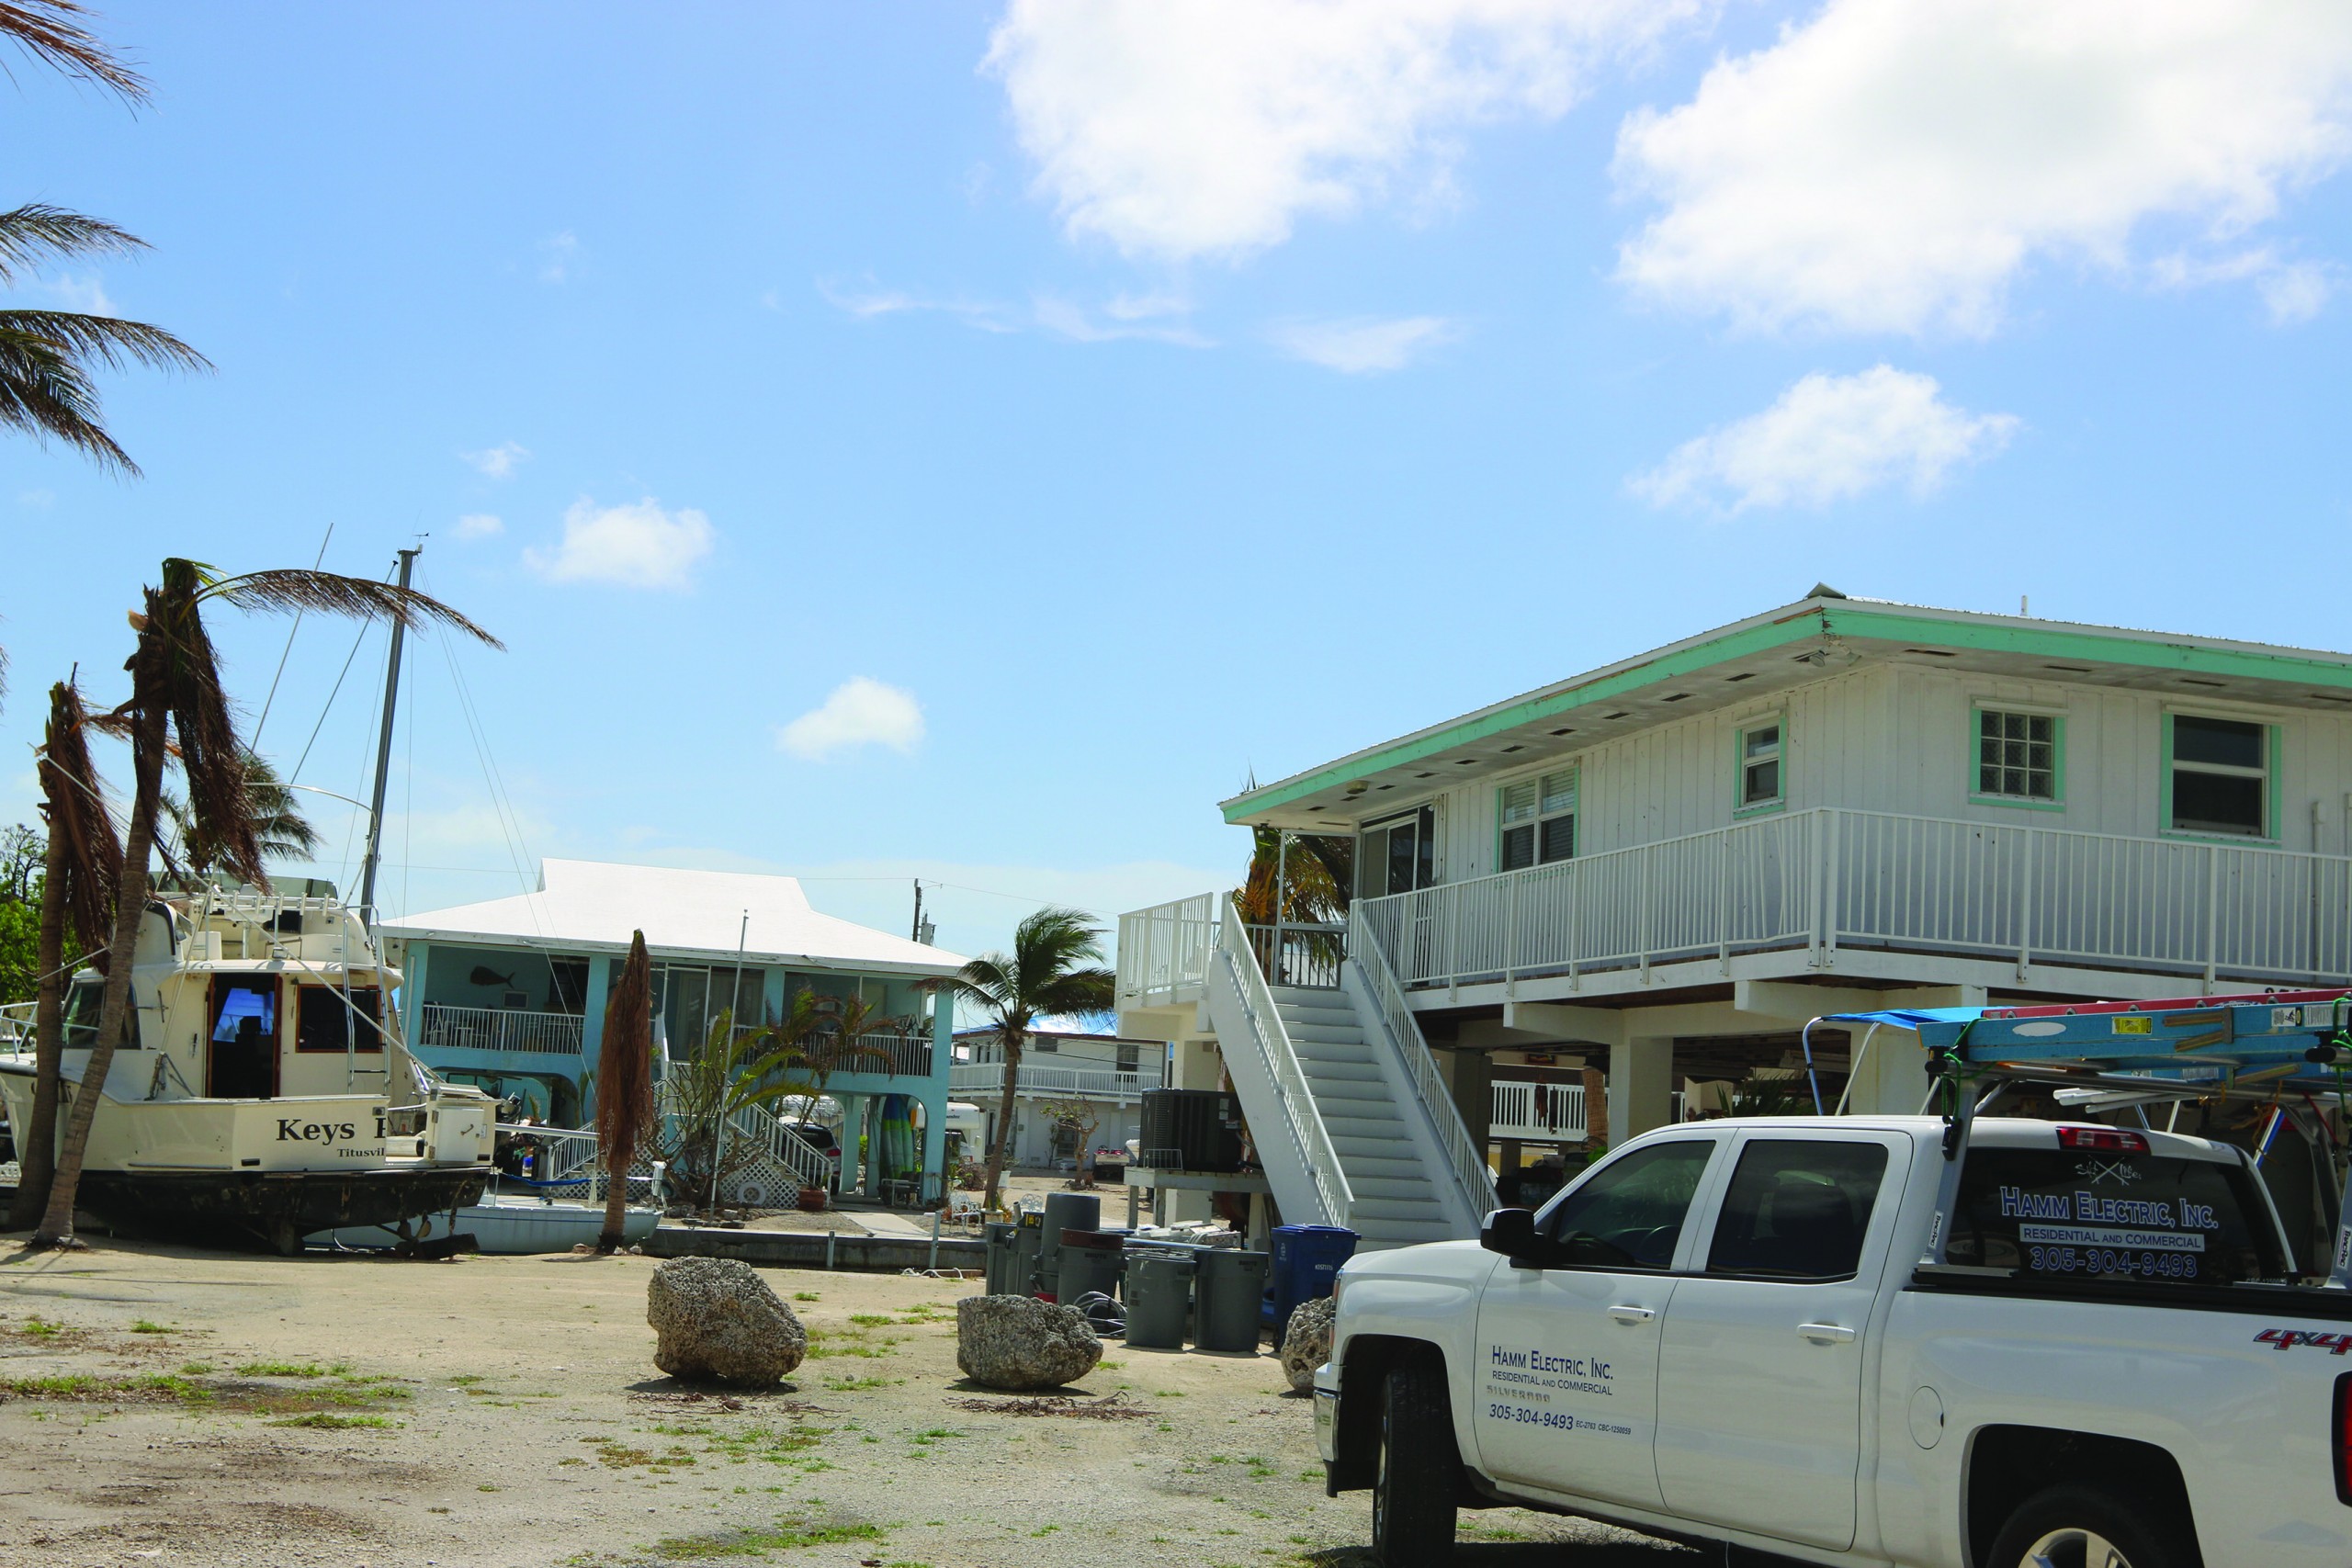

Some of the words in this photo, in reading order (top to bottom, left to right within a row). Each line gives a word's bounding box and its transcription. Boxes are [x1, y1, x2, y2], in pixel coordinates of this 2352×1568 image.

[276, 1119, 356, 1145] Keys
[1999, 1186, 2070, 1220] HAMM
[2075, 1190, 2176, 1229] ELECTRIC,
[2178, 1198, 2219, 1229] INC.
[2024, 1228, 2099, 1243] RESIDENTIAL
[2102, 1235, 2122, 1244] AND
[2125, 1234, 2200, 1248] COMMERCIAL
[2030, 1246, 2198, 1278] 305-304-9493
[1492, 1345, 1526, 1369] HAMM
[1531, 1349, 1587, 1378] ELECTRIC,
[1590, 1357, 1613, 1380] INC.
[1492, 1370, 1540, 1385] RESIDENTIAL
[1542, 1379, 1555, 1388] AND
[1557, 1379, 1612, 1395] COMMERCIAL
[1489, 1404, 1574, 1430] 305-304-9493
